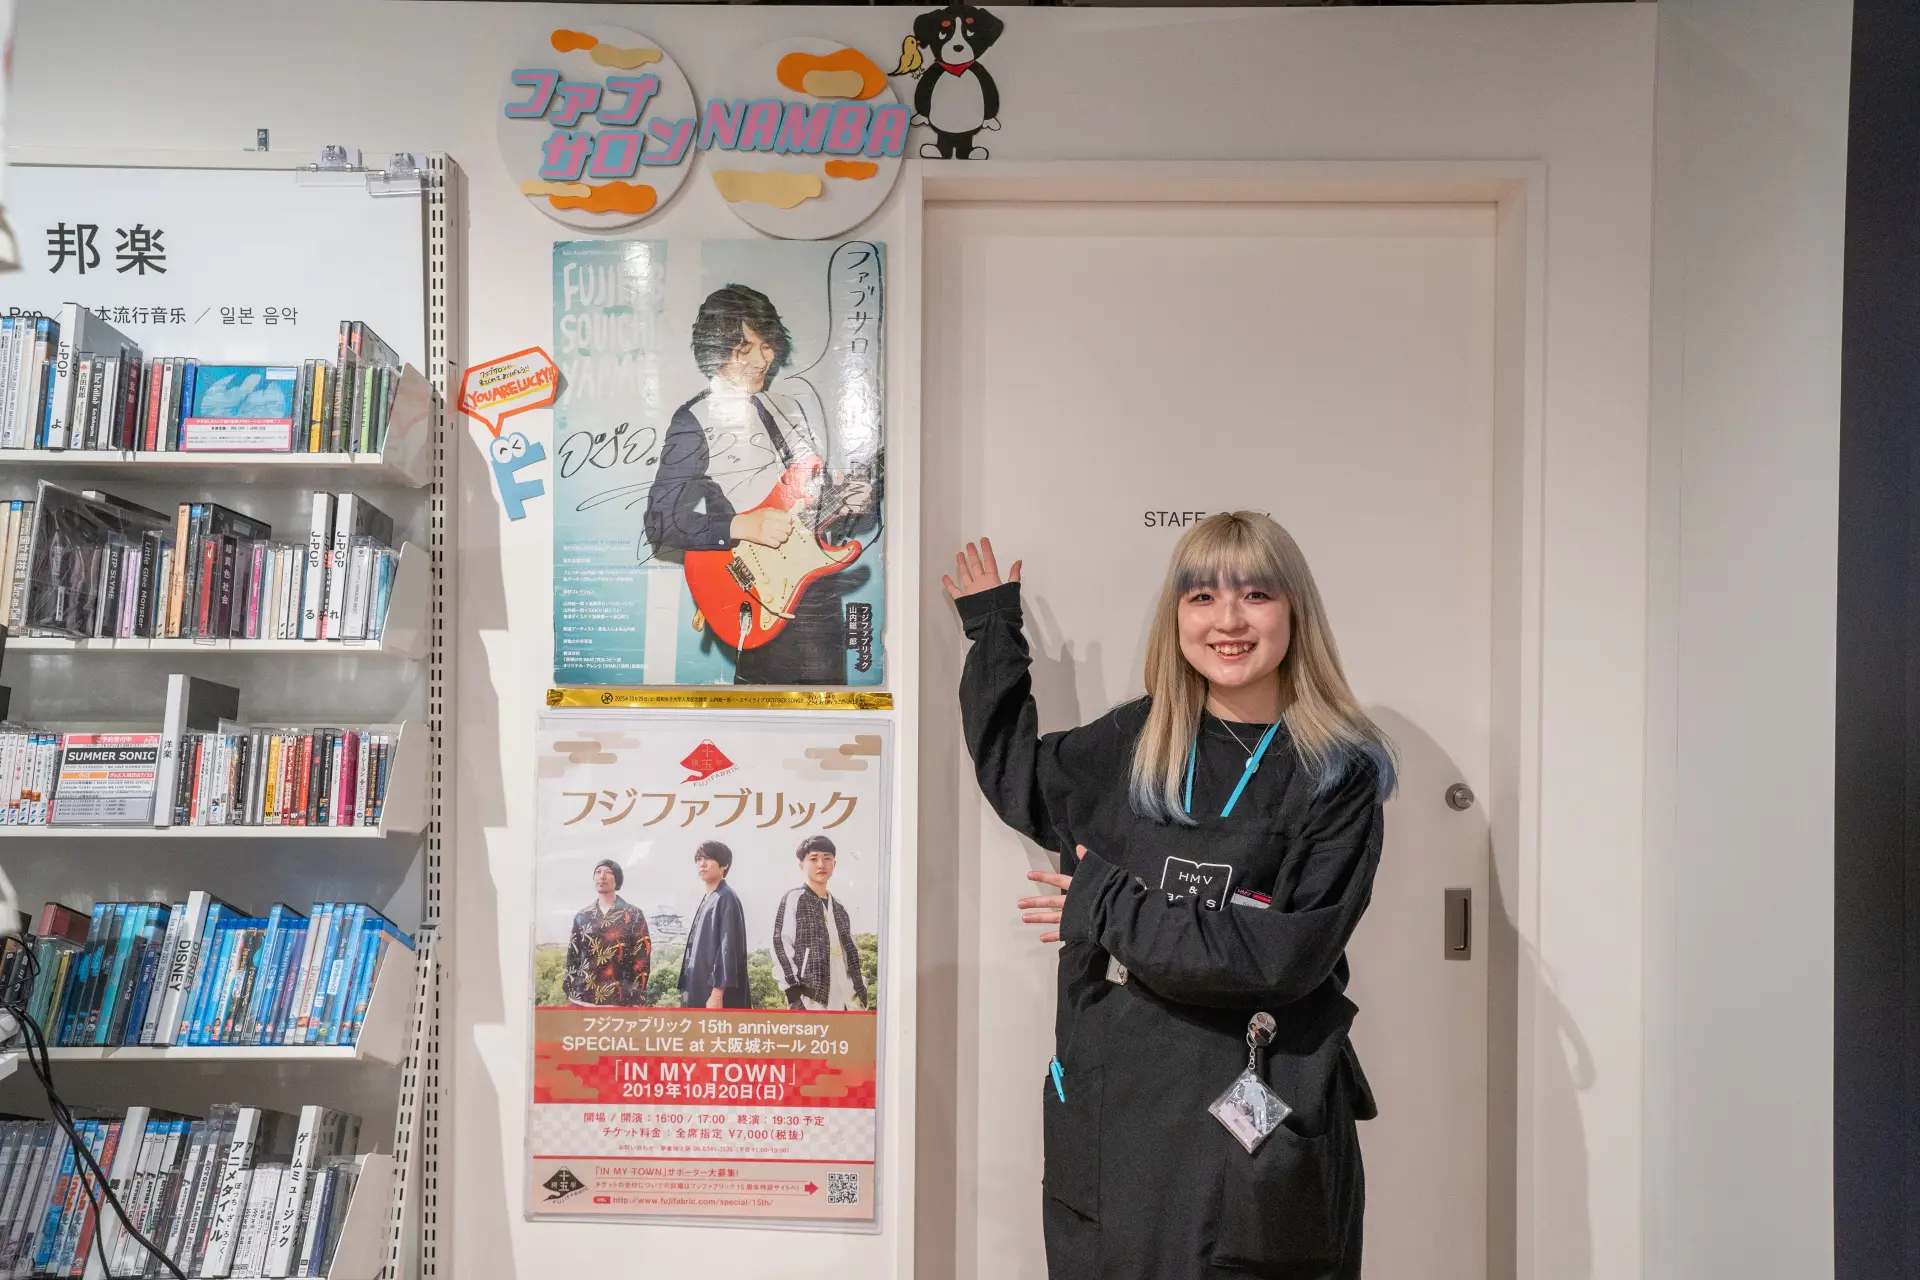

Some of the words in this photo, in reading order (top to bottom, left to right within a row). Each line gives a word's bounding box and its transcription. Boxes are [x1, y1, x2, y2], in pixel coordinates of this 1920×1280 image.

[504, 69, 659, 127] ファブ
[697, 98, 911, 157] NAMBA
[539, 117, 696, 181] サロン
[47, 222, 167, 275] 邦楽
[84, 306, 186, 325] 本流行音乐
[220, 307, 255, 325] 일본
[262, 307, 299, 325] 음악
[57, 341, 69, 378] J-POP
[467, 390, 492, 408] YOU
[493, 380, 519, 401] ARE
[309, 531, 321, 567] J-POP
[335, 531, 346, 568] J-POP
[108, 569, 117, 599] SLYME
[138, 588, 146, 628] Monster
[305, 609, 315, 620] る
[330, 609, 339, 620] れ
[861, 606, 870, 670] フジファブリック
[68, 751, 116, 761] SUMMER
[118, 751, 155, 760] SONIC
[163, 740, 172, 758] 洋楽
[693, 764, 740, 788] FUJIFABRIC
[562, 787, 858, 830] フジファブリック
[1179, 872, 1213, 884] HMV
[169, 940, 191, 992] DISNEY
[583, 1017, 693, 1033] フジファブリック
[698, 1018, 732, 1034] 15th
[737, 1020, 829, 1039] anniversary
[562, 1037, 640, 1052] SPECIAL
[645, 1037, 684, 1052] LIVE
[689, 1039, 705, 1053] at
[710, 1038, 806, 1054] 大阪城ホール
[810, 1039, 849, 1055] 2019
[660, 1062, 696, 1082] MY
[583, 1112, 605, 1123] 開場
[697, 1114, 725, 1124] 17:00
[804, 1115, 825, 1127] 予定
[201, 1159, 212, 1192] ACTORS
[613, 1167, 628, 1176] MY
[210, 1141, 244, 1242] アニメタイトル
[279, 1133, 309, 1247] ゲームミュージック
[191, 1200, 202, 1234] LEAGUE
